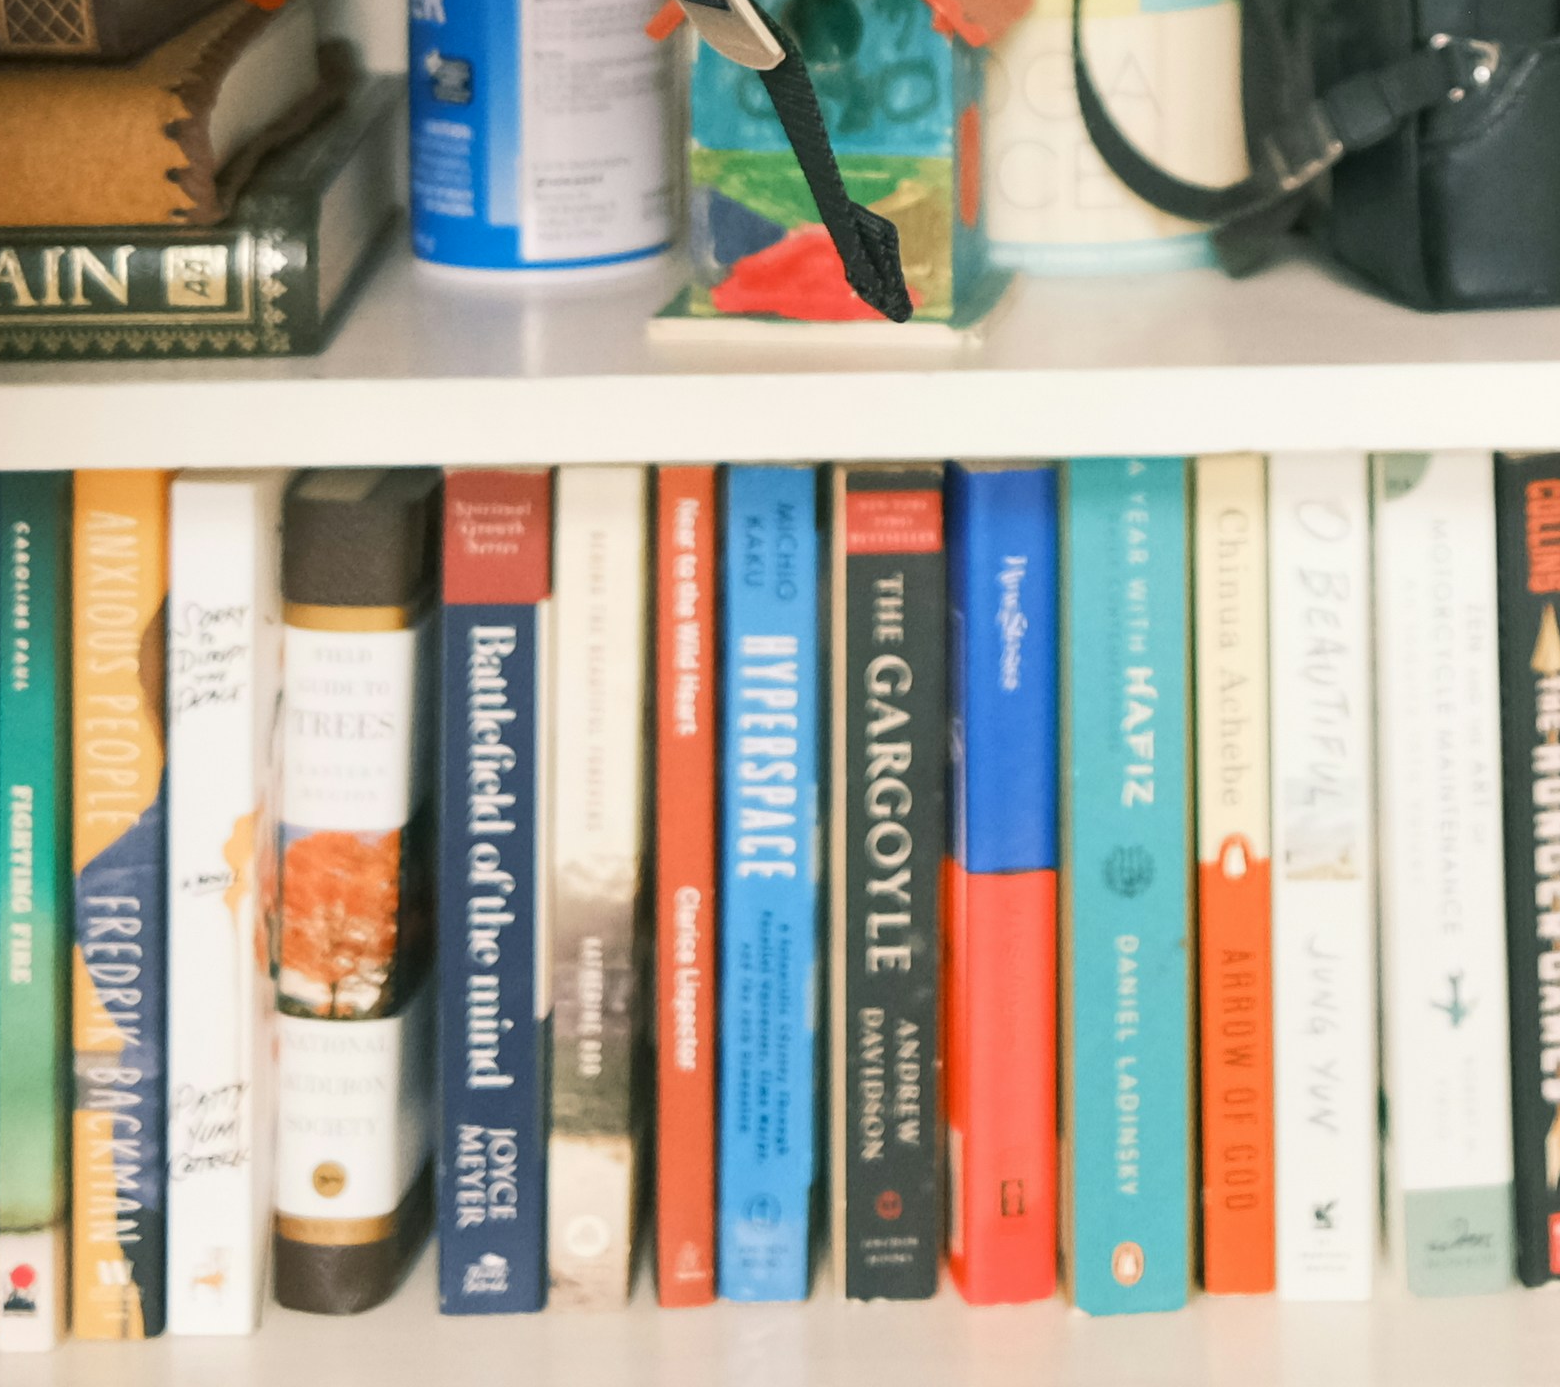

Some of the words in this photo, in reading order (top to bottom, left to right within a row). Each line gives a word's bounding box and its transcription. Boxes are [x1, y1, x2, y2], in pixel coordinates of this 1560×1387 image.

[1127, 460, 1147, 475] A
[677, 499, 698, 547] Near
[677, 553, 698, 574] to
[744, 517, 767, 588] KAKU
[775, 503, 799, 601] MICHIO
[1127, 493, 1148, 565] YEAR
[1295, 499, 1351, 540] O
[13, 523, 31, 627] CAROLINE
[84, 511, 138, 673] ANXIOUS
[677, 582, 698, 617] the
[874, 574, 904, 643] THE
[1126, 579, 1148, 654] WITH
[1216, 508, 1250, 651] Chinua
[677, 623, 700, 668] Wild
[1300, 568, 1351, 806] BEAUTIFUL
[467, 625, 516, 835] Battlefield
[677, 675, 700, 735] Heart
[1121, 668, 1156, 807] HAFIZ
[1218, 668, 1253, 806] Achebe
[85, 697, 138, 827] PEOPLE
[738, 636, 799, 878] HYPERSPACE
[10, 786, 32, 913] FIGHTING
[867, 655, 913, 972] GARGOYLE
[467, 846, 516, 893] of
[10, 924, 32, 984] FIRE
[84, 896, 141, 1045] FREDRIK
[467, 896, 516, 966] the
[676, 887, 700, 962] Clarice
[468, 975, 515, 1088] mind
[673, 968, 700, 1070] Lispector
[1116, 936, 1140, 1042] DANIEL
[1220, 950, 1256, 1066] ARROW
[1304, 936, 1340, 1036] JUNG
[861, 1009, 886, 1159] DAVIDSON
[895, 1020, 920, 1144] ANDREW
[1116, 1057, 1141, 1196] LADINSKY
[1223, 1087, 1256, 1129] OF
[1306, 1060, 1340, 1136] YUN
[88, 1068, 141, 1243] BACKMAN
[455, 1124, 485, 1228] MEYER
[488, 1127, 516, 1219] JOYCE
[1225, 1146, 1258, 1212] GOD
